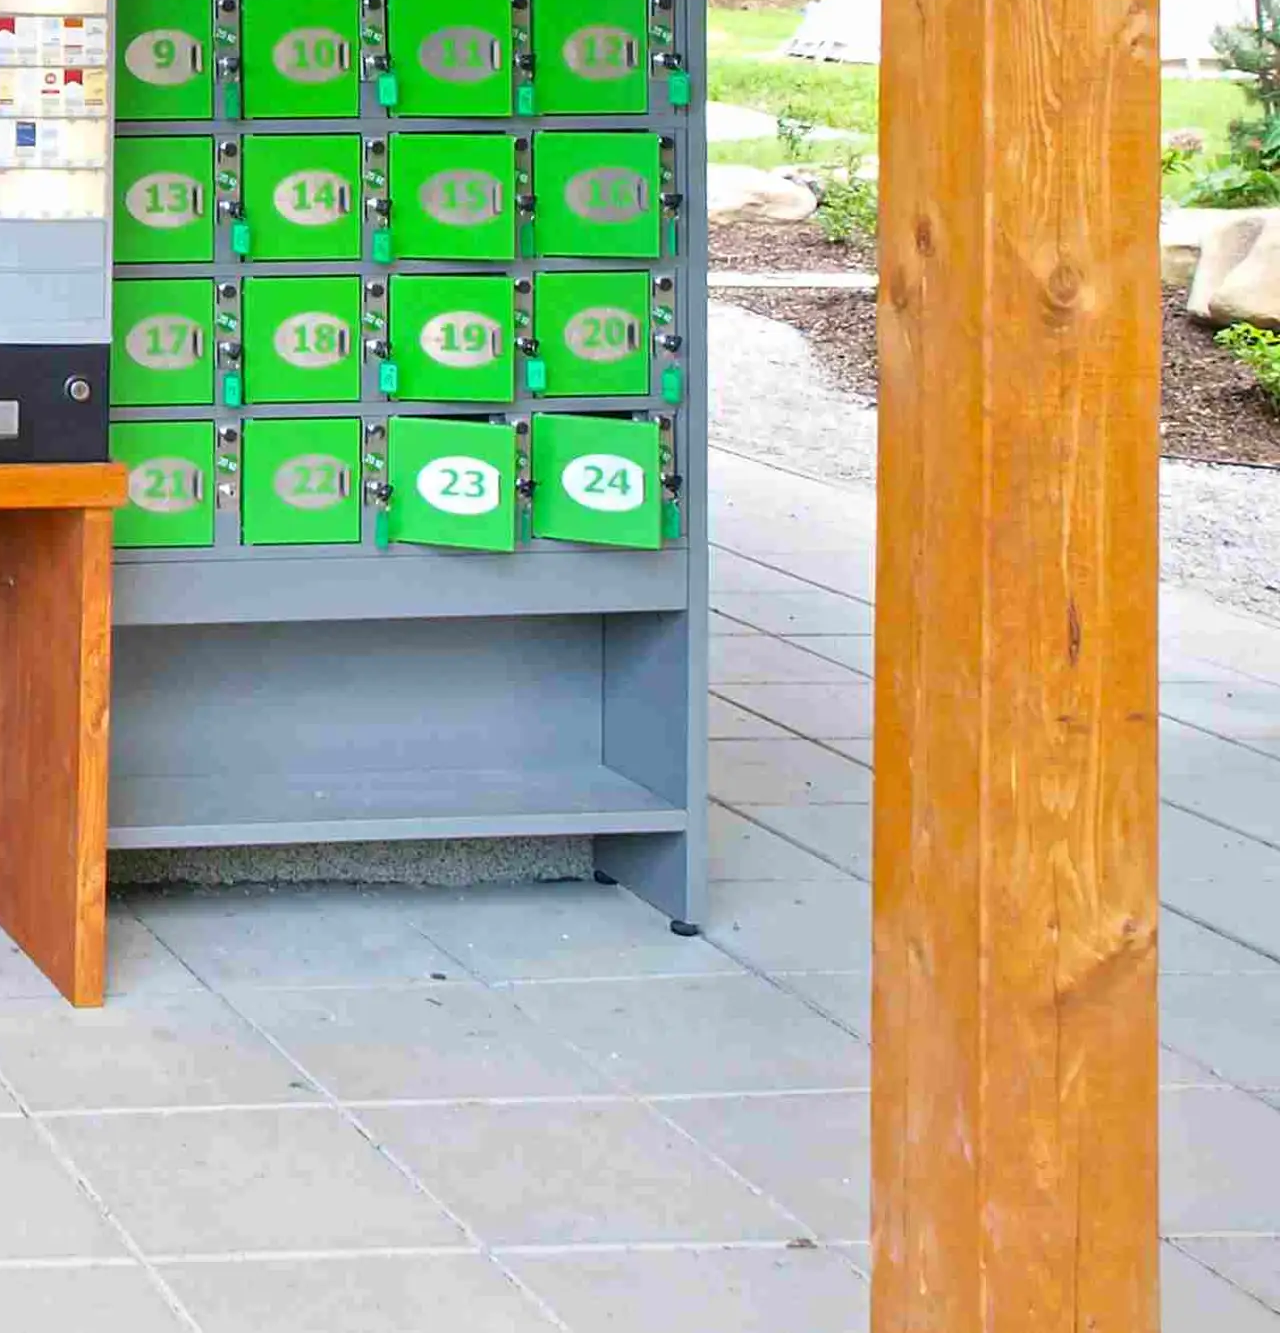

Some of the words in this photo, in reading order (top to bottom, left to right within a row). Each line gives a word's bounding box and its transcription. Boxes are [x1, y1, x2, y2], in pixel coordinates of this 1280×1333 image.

[153, 39, 176, 67] 9
[293, 39, 334, 67] 10
[441, 38, 485, 67] 11
[583, 38, 624, 66] 12
[145, 183, 188, 213] 13
[292, 181, 335, 210] 14
[441, 180, 485, 210] 15
[585, 178, 633, 207] 16
[146, 325, 187, 355] 17
[293, 325, 336, 354] 18
[440, 323, 485, 352] 19
[581, 319, 625, 348] 20
[145, 469, 187, 499] 21
[292, 467, 335, 496] 22
[440, 469, 485, 498] 23
[583, 466, 630, 495] 24
